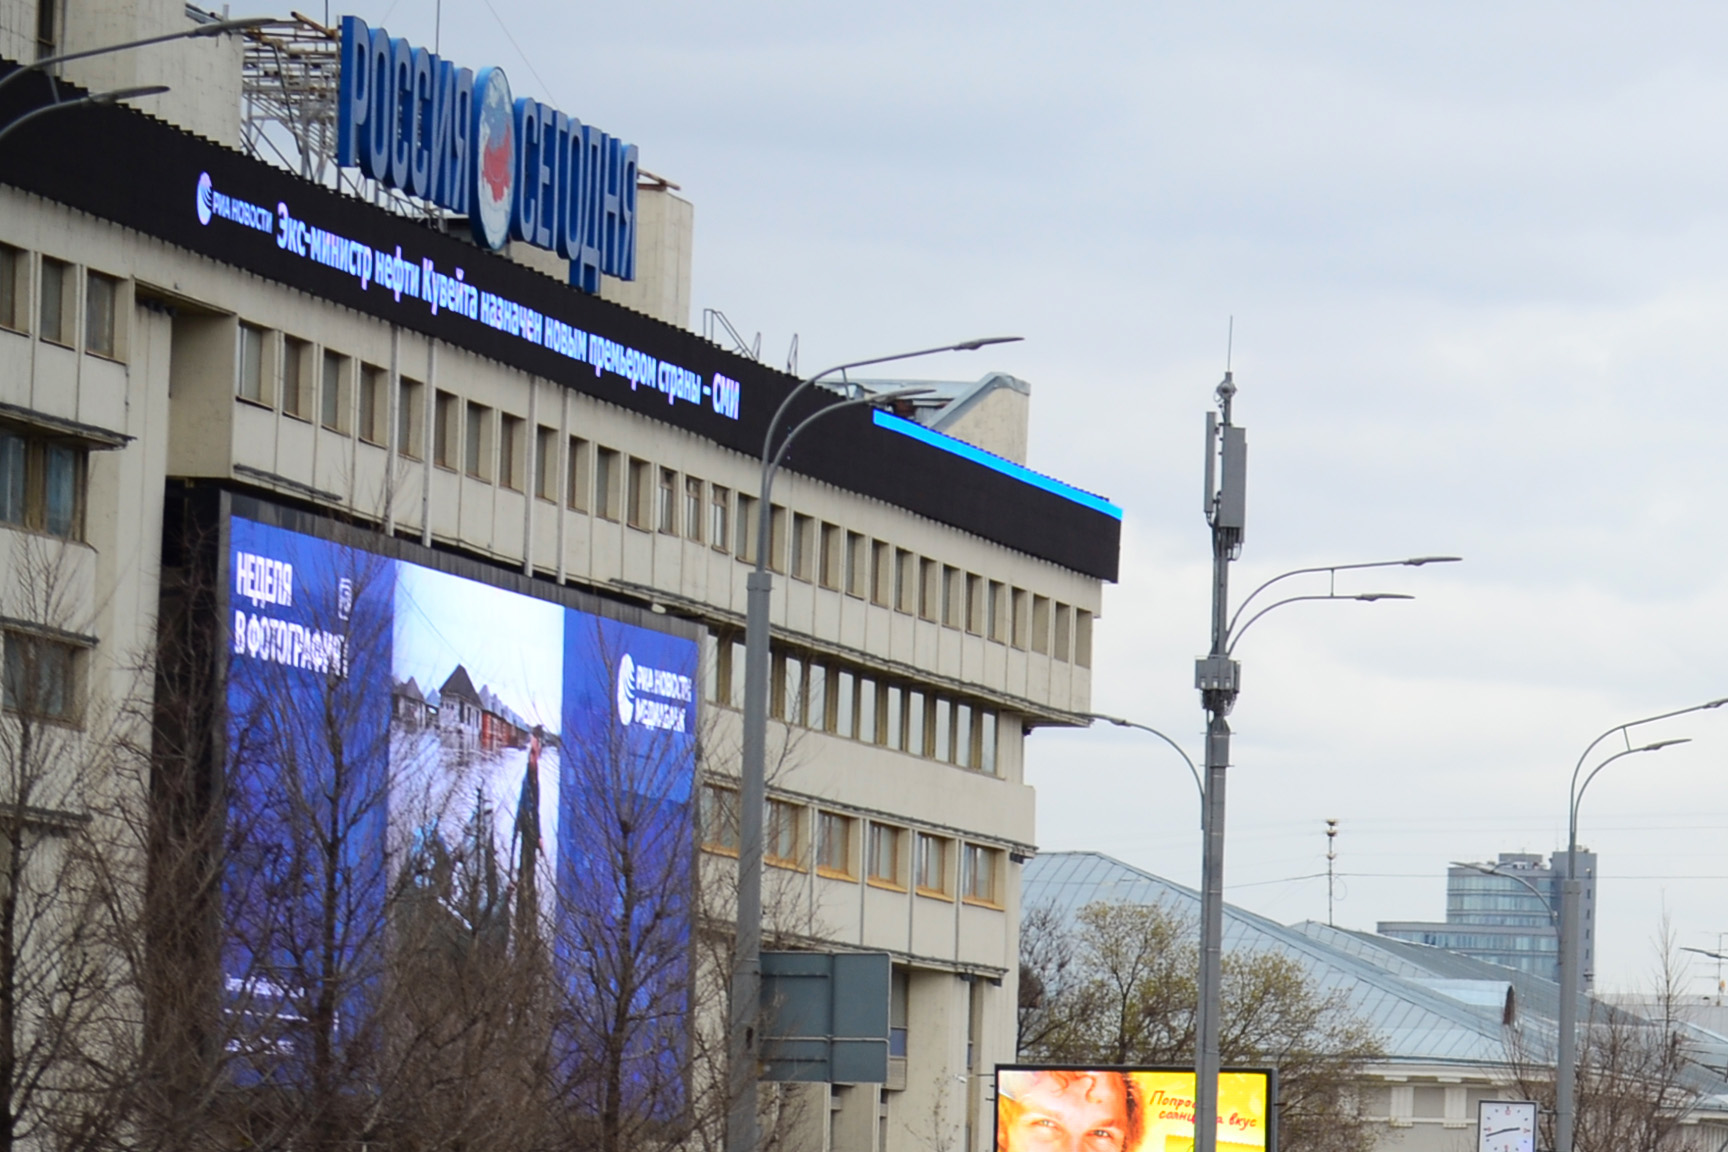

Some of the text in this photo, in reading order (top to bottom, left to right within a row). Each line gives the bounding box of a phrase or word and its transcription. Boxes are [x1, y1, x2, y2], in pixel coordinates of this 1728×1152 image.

[338, 15, 639, 294] РОССИЯ СЕГОДНЯ
[212, 190, 273, 235] РИА НОВОСТИ
[276, 201, 373, 291] Экс-министр
[374, 246, 420, 303] нефти
[421, 256, 479, 321] Кувейта
[480, 290, 543, 345] назначен
[544, 315, 588, 363] новым
[588, 332, 657, 392] премьером
[657, 359, 702, 406] страны
[712, 371, 741, 421] СМИ
[235, 551, 293, 609] НЕДЕЛЯ
[234, 609, 246, 654] В
[1148, 1089, 1197, 1110] Попро
[1228, 1112, 1257, 1131] вкус
